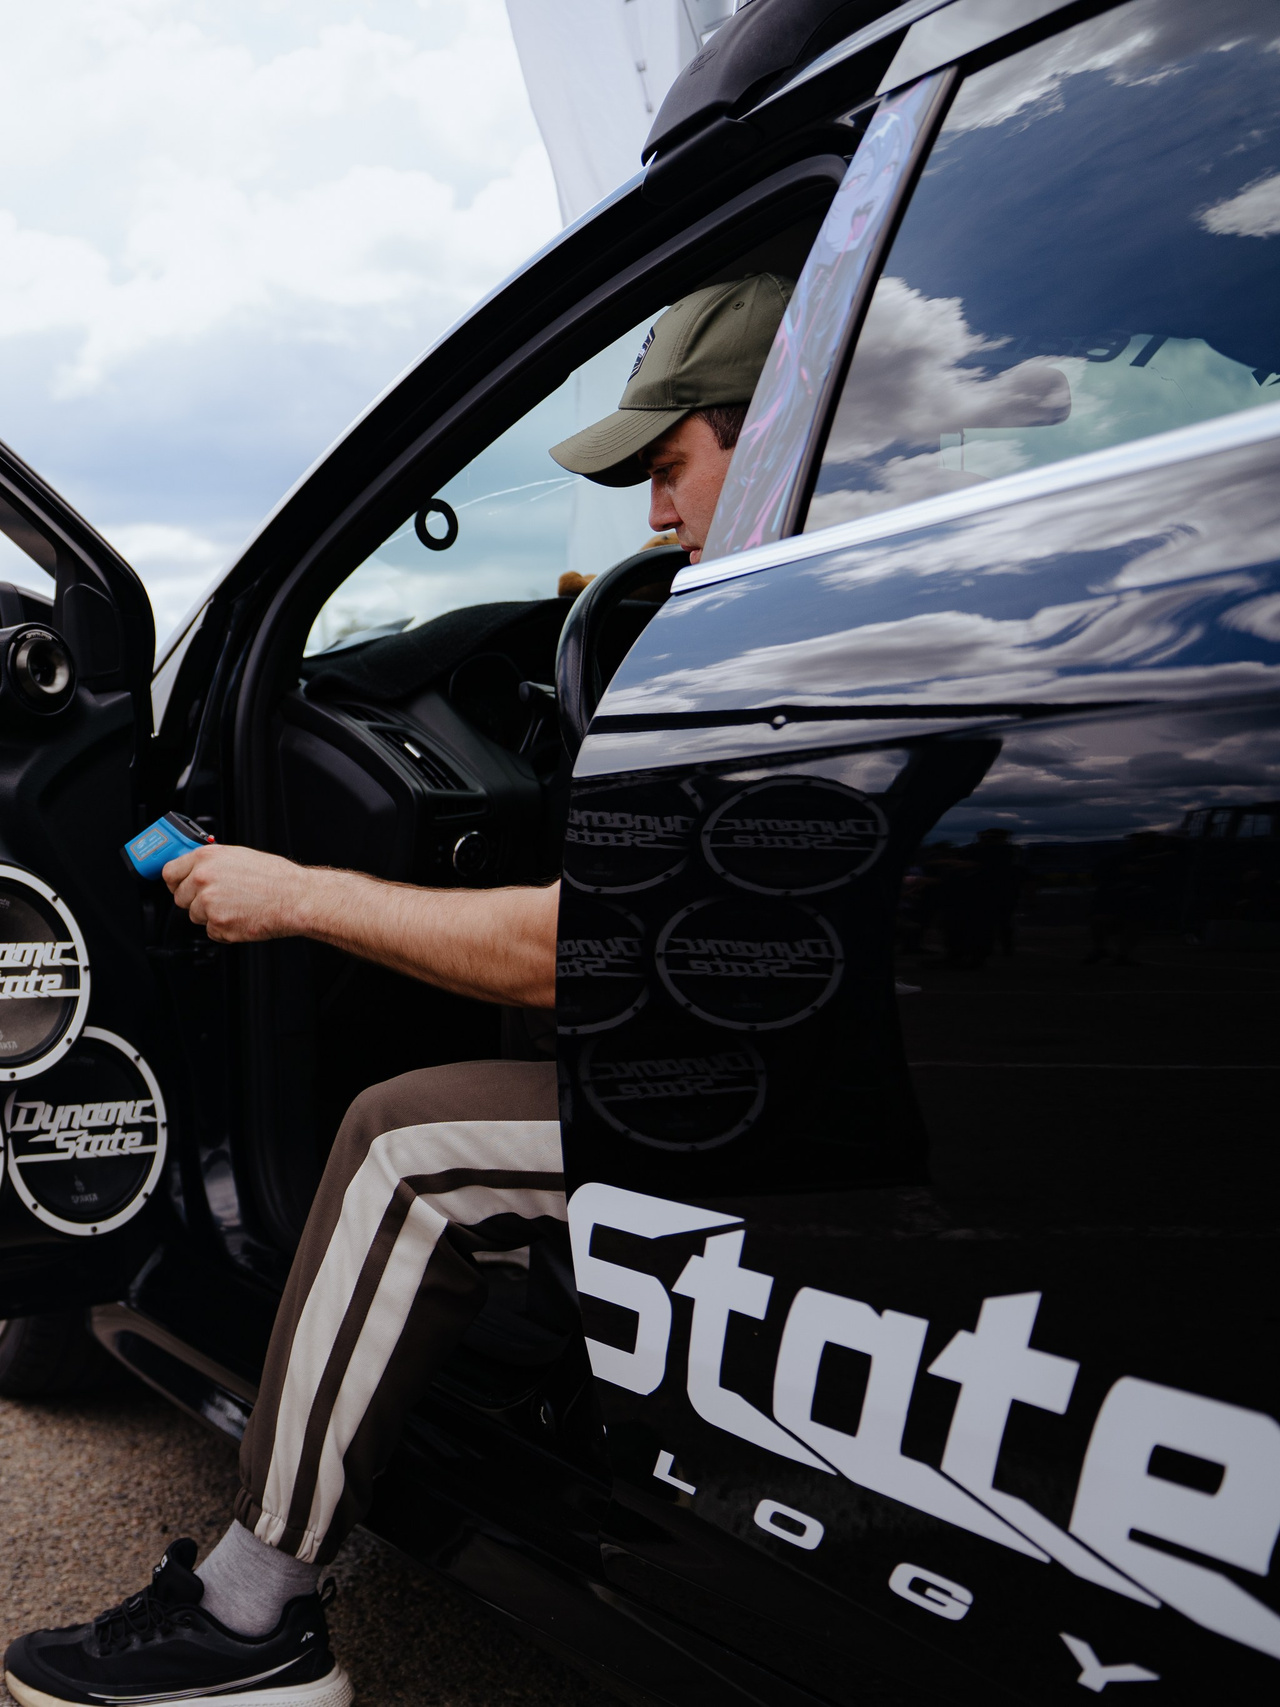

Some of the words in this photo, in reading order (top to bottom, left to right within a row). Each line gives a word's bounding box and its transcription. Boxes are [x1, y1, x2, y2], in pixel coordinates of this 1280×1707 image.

[11, 1099, 158, 1143] Dynamic
[55, 1128, 143, 1159] State
[567, 1182, 1280, 1660] State
